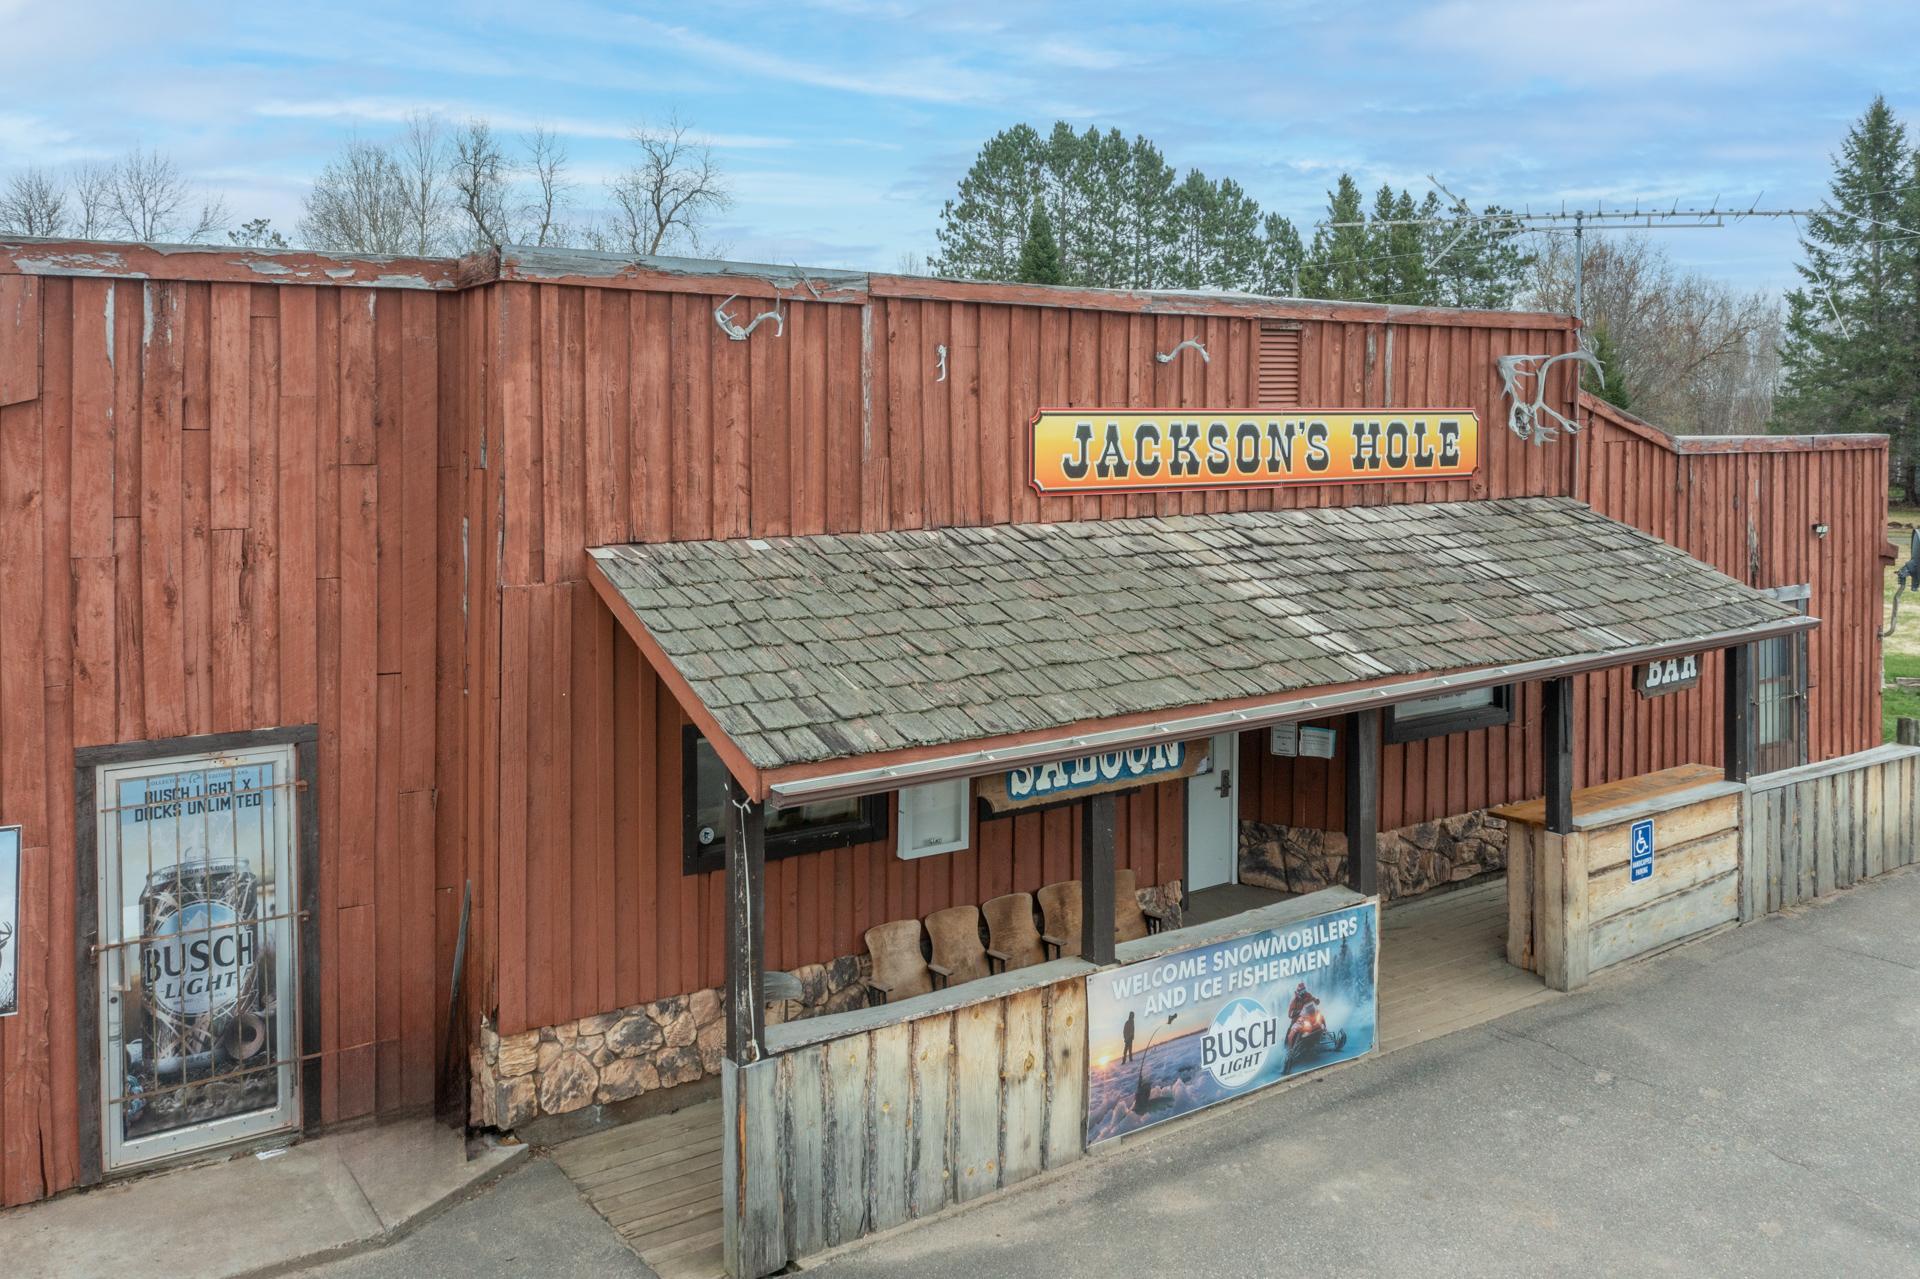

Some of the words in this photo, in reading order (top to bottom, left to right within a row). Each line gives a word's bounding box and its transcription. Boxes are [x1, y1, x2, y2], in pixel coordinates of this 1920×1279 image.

[1062, 420, 1330, 479] JACKSON'S
[1351, 421, 1461, 470] HOLE
[187, 792, 262, 816] UNLIMTED
[242, 778, 252, 791] X
[146, 932, 253, 984] BUSCH
[1111, 956, 1207, 1000] WELCOME
[1213, 916, 1358, 971] SNOWMOBILERS
[1143, 986, 1187, 1018] AND
[1194, 976, 1222, 1001] ICE
[1229, 948, 1331, 992] FISHERMEN
[1202, 1018, 1277, 1066] BUSCH
[1220, 1051, 1262, 1077] LIGHT
